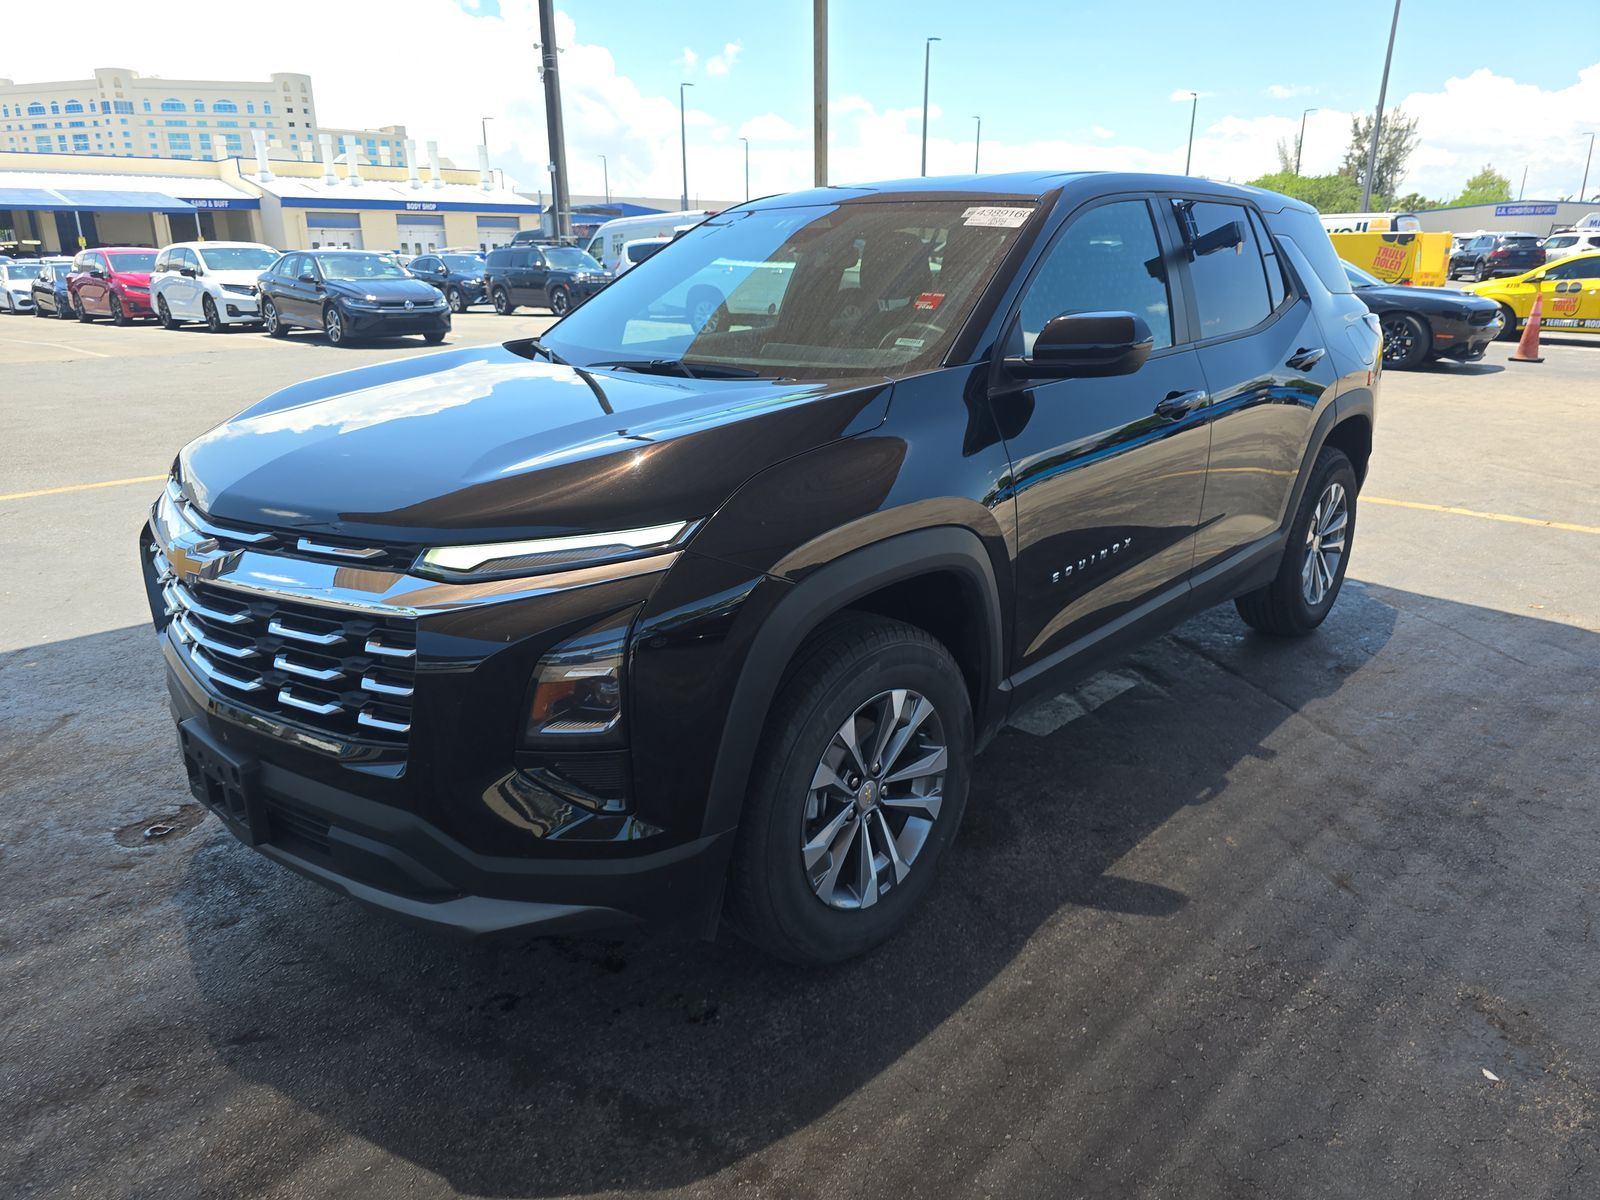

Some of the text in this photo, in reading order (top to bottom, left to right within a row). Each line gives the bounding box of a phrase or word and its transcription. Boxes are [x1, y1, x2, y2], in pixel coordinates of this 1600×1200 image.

[406, 202, 422, 210] BODY
[1376, 246, 1407, 261] TRULY
[1372, 257, 1402, 272] NOLEN
[1546, 318, 1579, 327] TERMITE
[1052, 537, 1132, 583] EQUINOX
